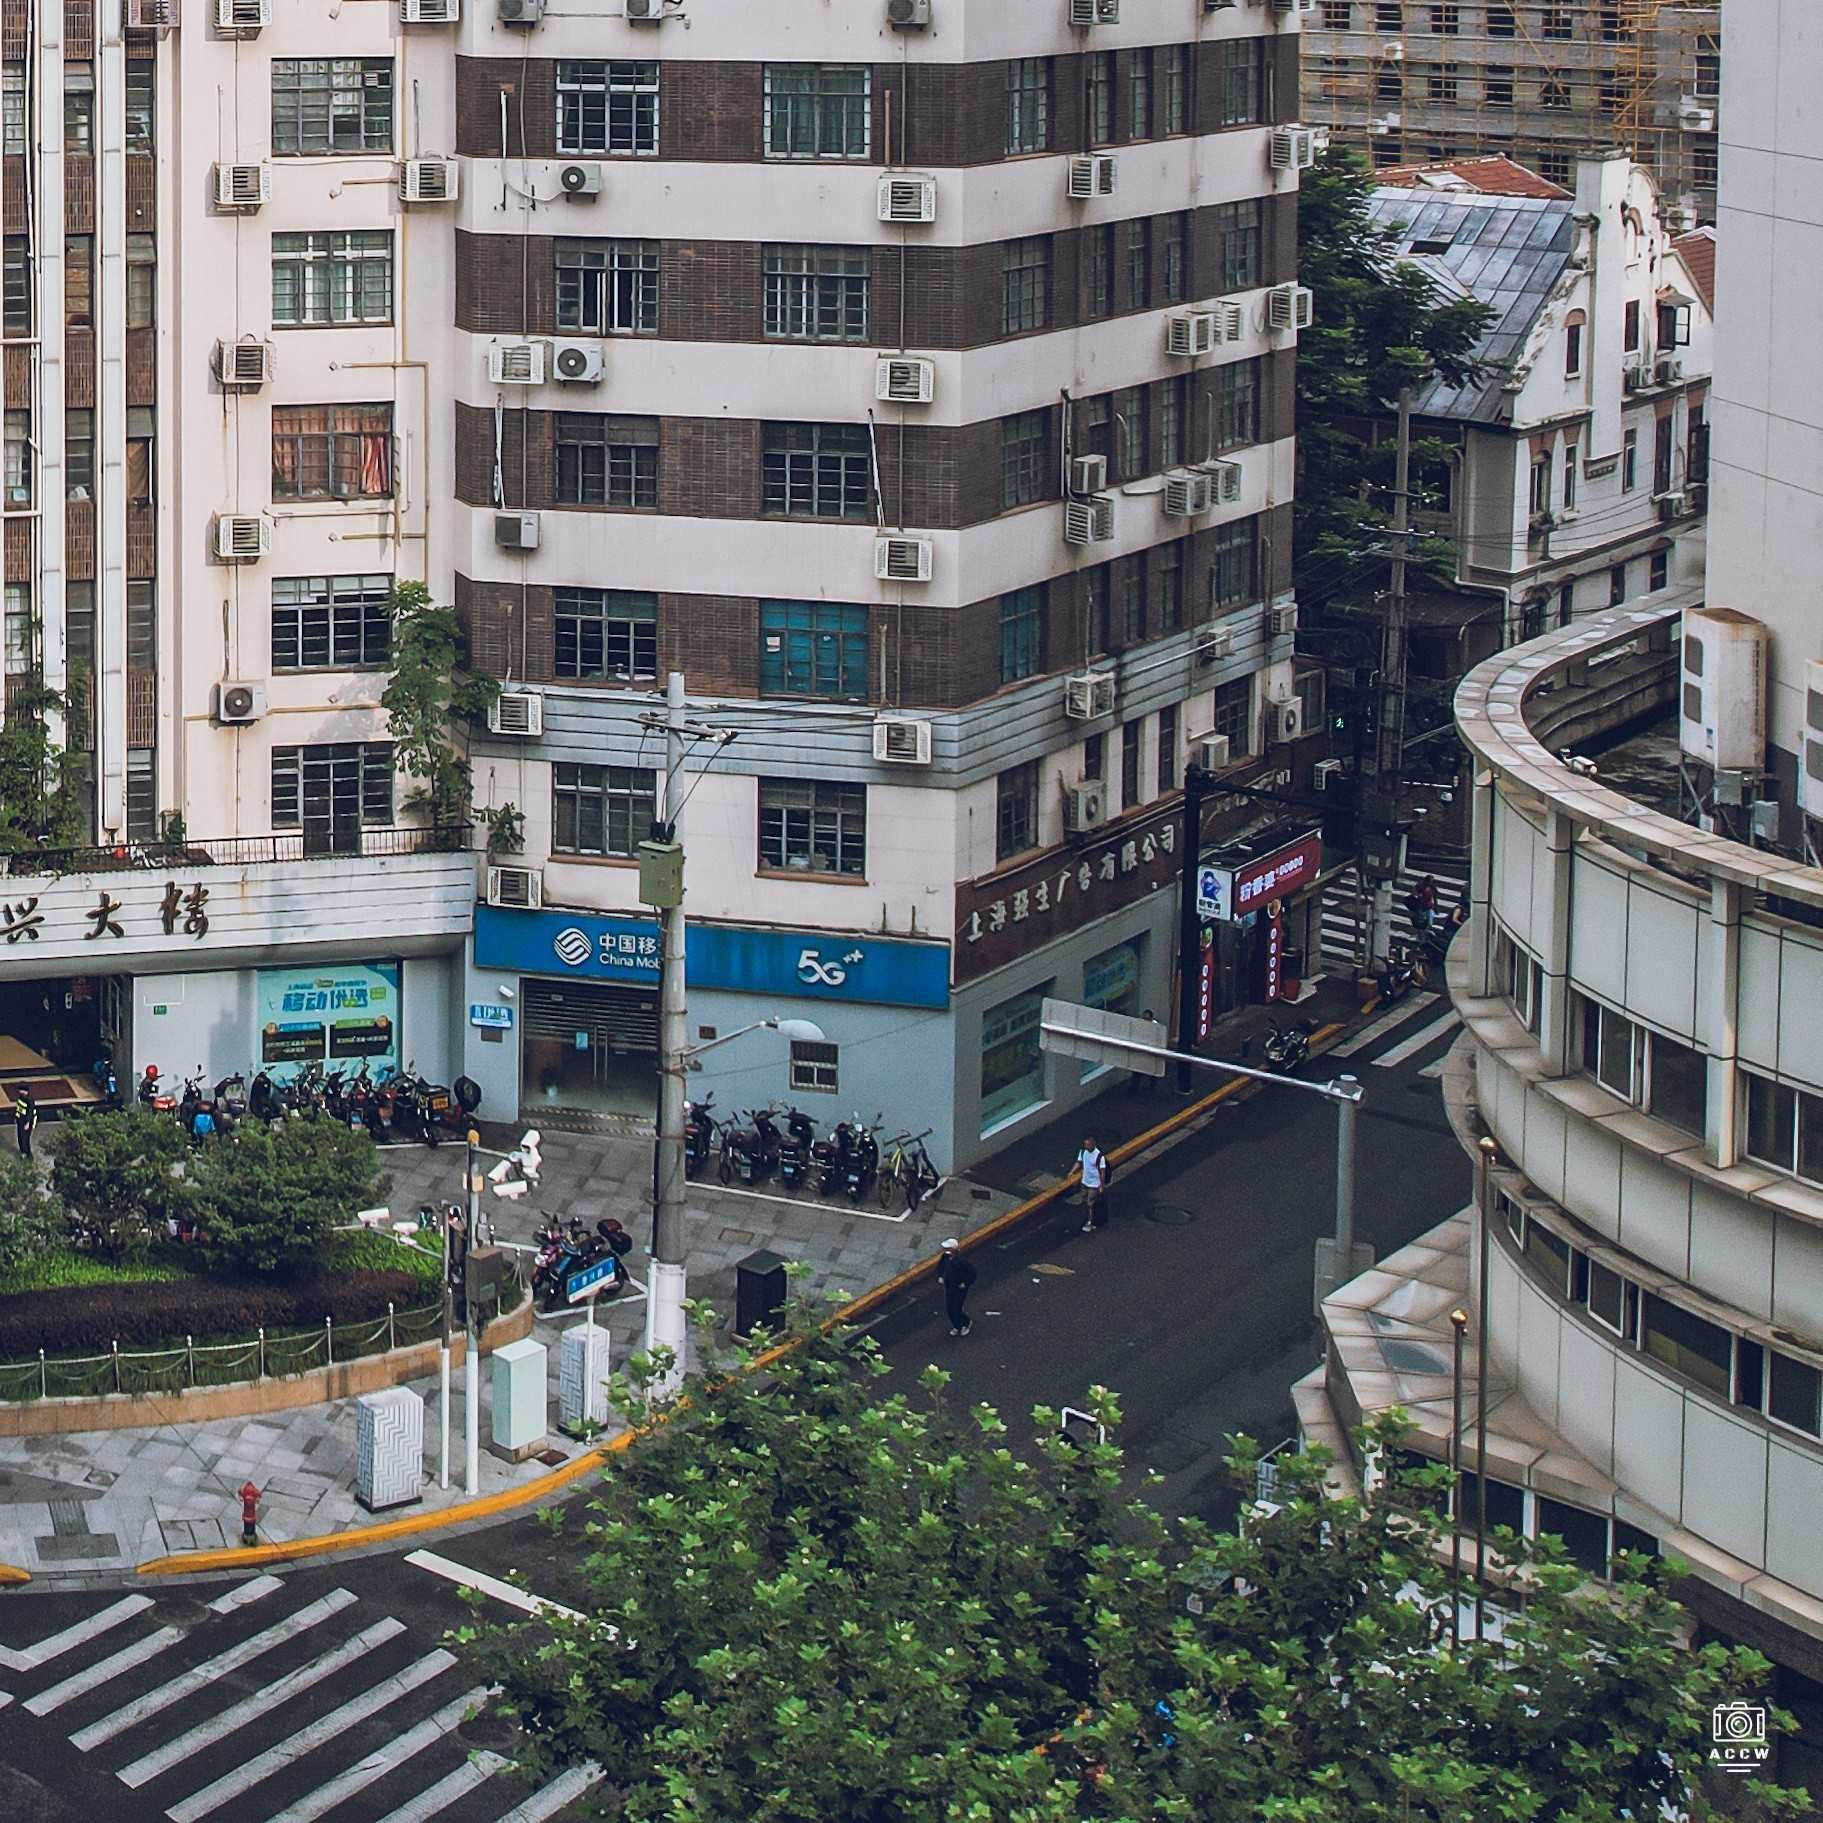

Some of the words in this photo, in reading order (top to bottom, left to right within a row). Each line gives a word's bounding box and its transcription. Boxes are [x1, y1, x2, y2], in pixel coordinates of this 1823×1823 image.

[599, 932, 661, 955] 中国移
[599, 953, 634, 967] China
[636, 955, 662, 970] Mob
